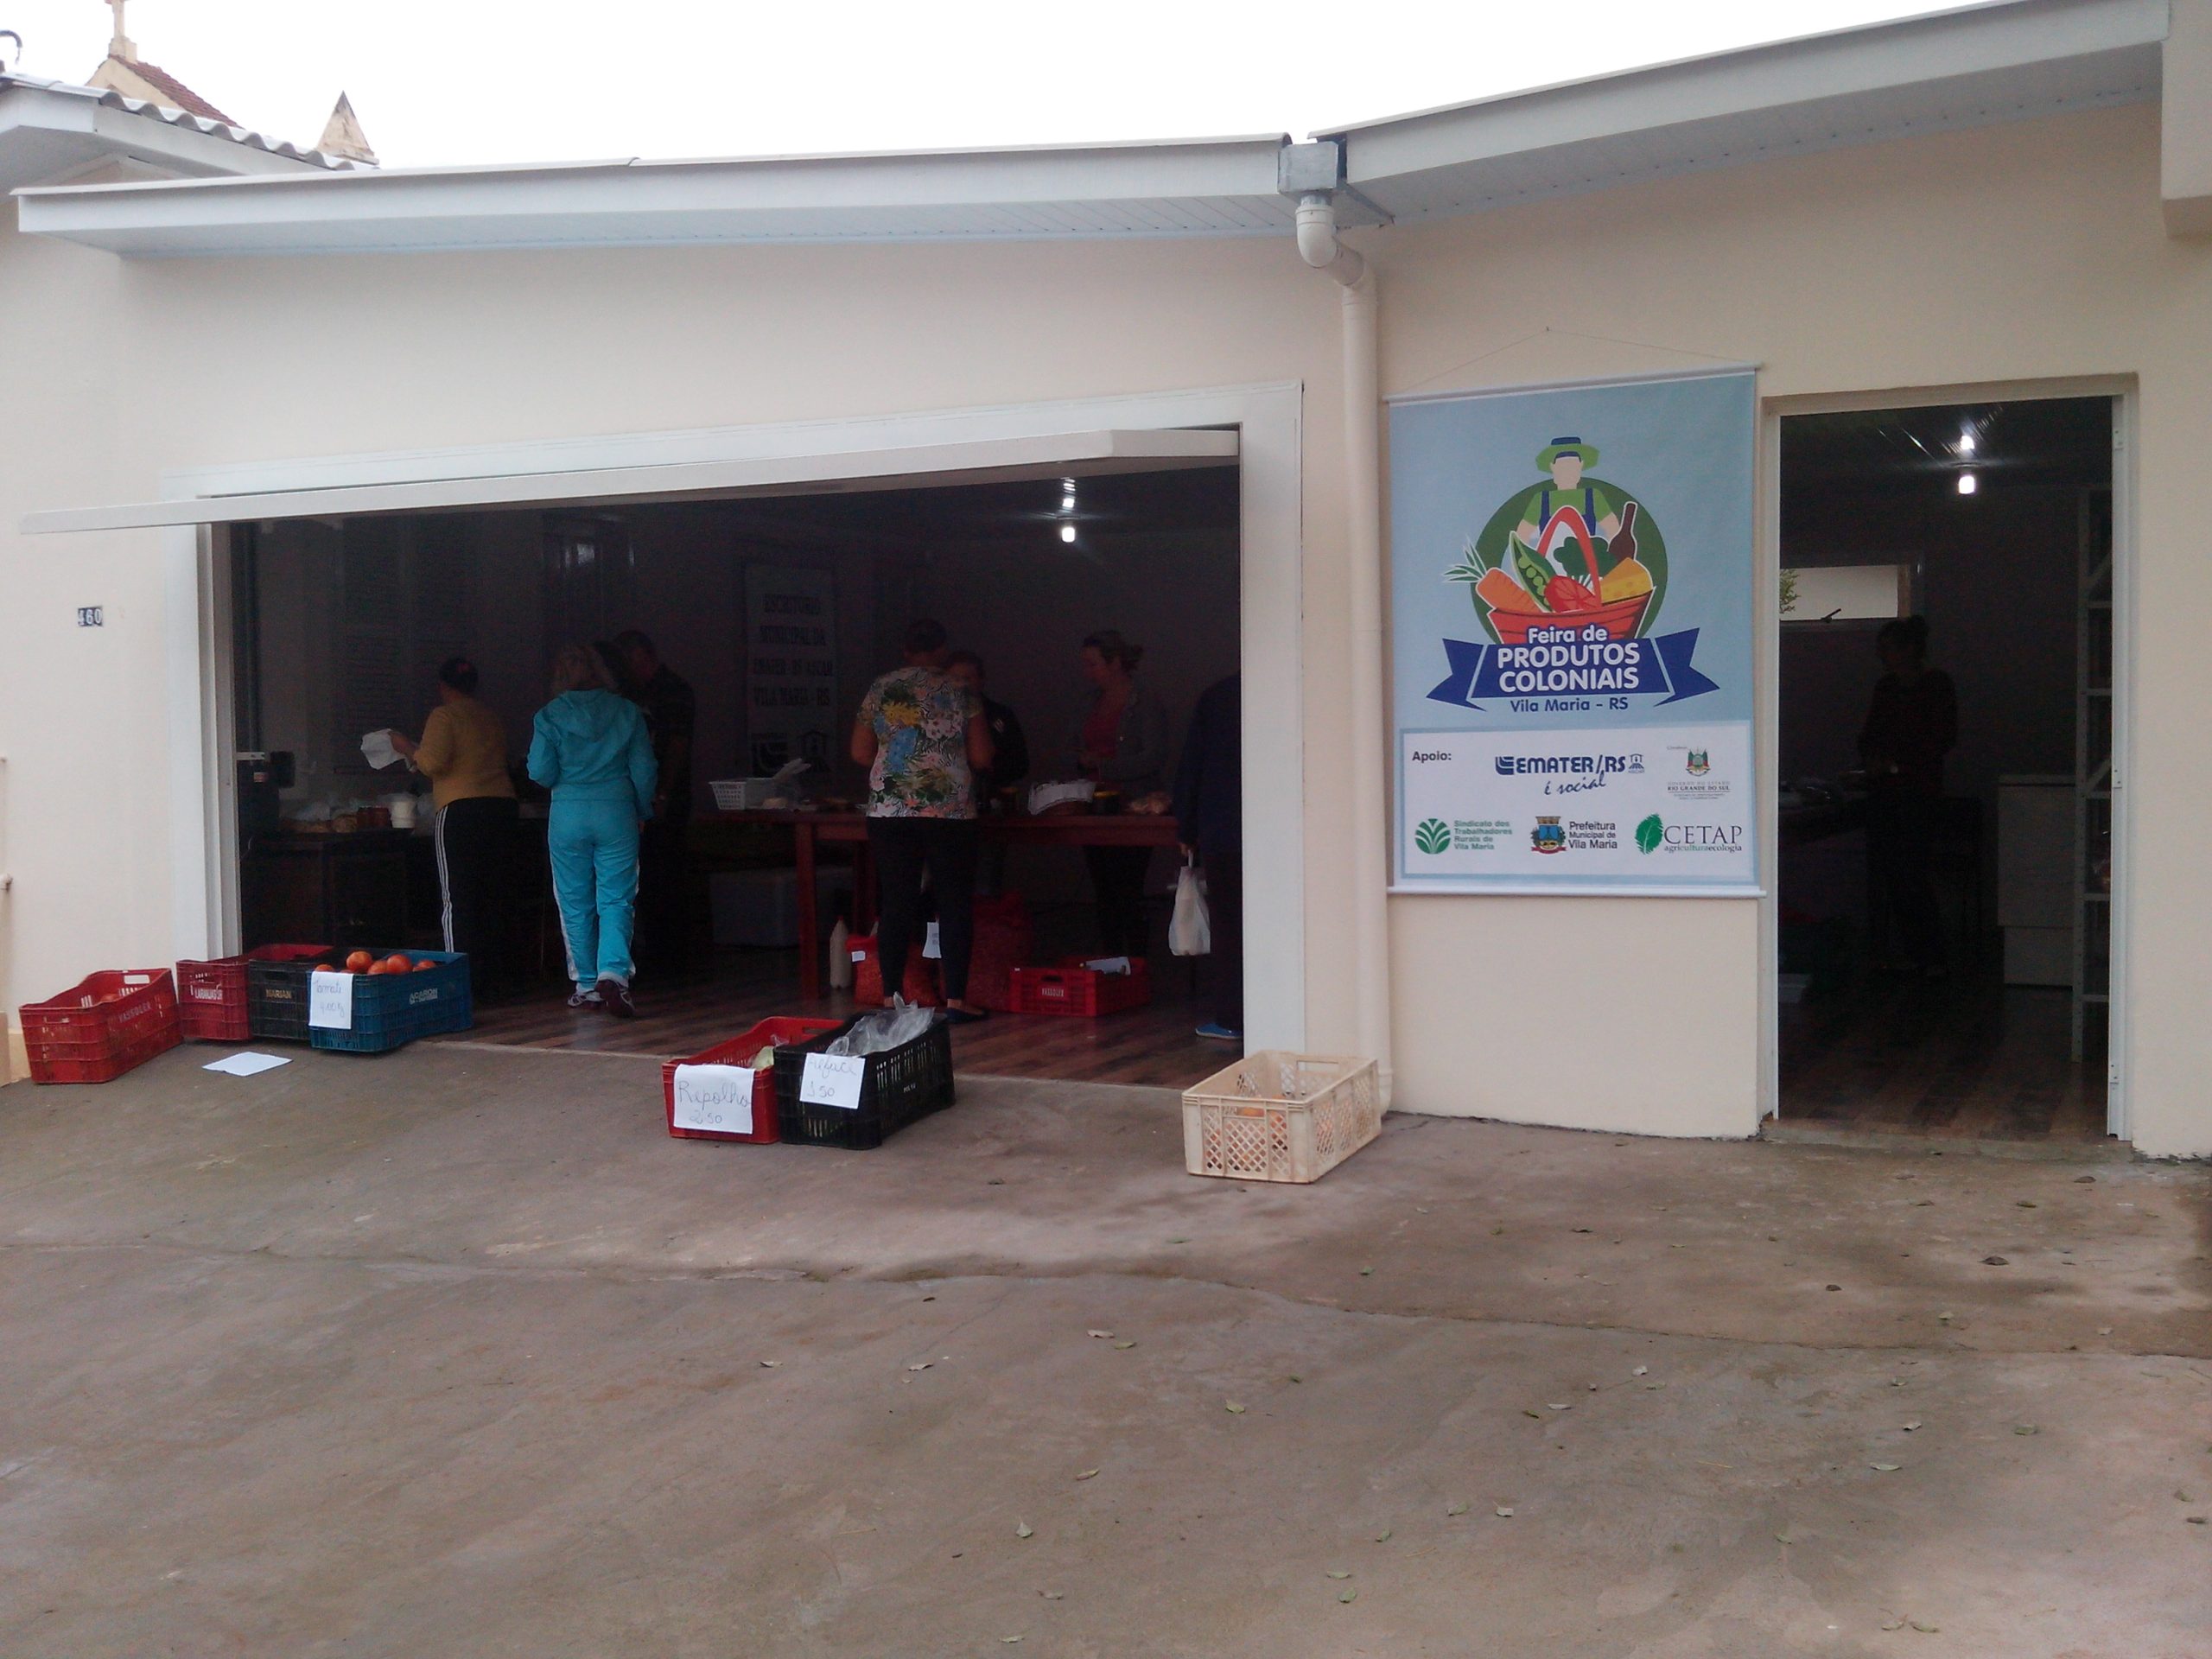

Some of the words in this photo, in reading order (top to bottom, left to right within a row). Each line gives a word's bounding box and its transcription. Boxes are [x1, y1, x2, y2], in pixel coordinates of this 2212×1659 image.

[1529, 626, 1575, 644] Feira
[1582, 625, 1607, 642] de
[1497, 643, 1640, 669] PRODUTOS
[1499, 667, 1639, 692] COLONIAIS
[1510, 699, 1539, 712] Vila
[1544, 698, 1590, 712] Maria
[1609, 697, 1628, 710] RS
[1412, 751, 1452, 764] Apoio:
[1557, 770, 1606, 794] social
[1569, 821, 1616, 830] Prefeitura
[1569, 830, 1605, 839] Municipal
[1664, 825, 1742, 844] CETAP
[1568, 839, 1586, 849] Vila
[1590, 839, 1618, 849] Maria
[678, 1080, 751, 1111] Repolho
